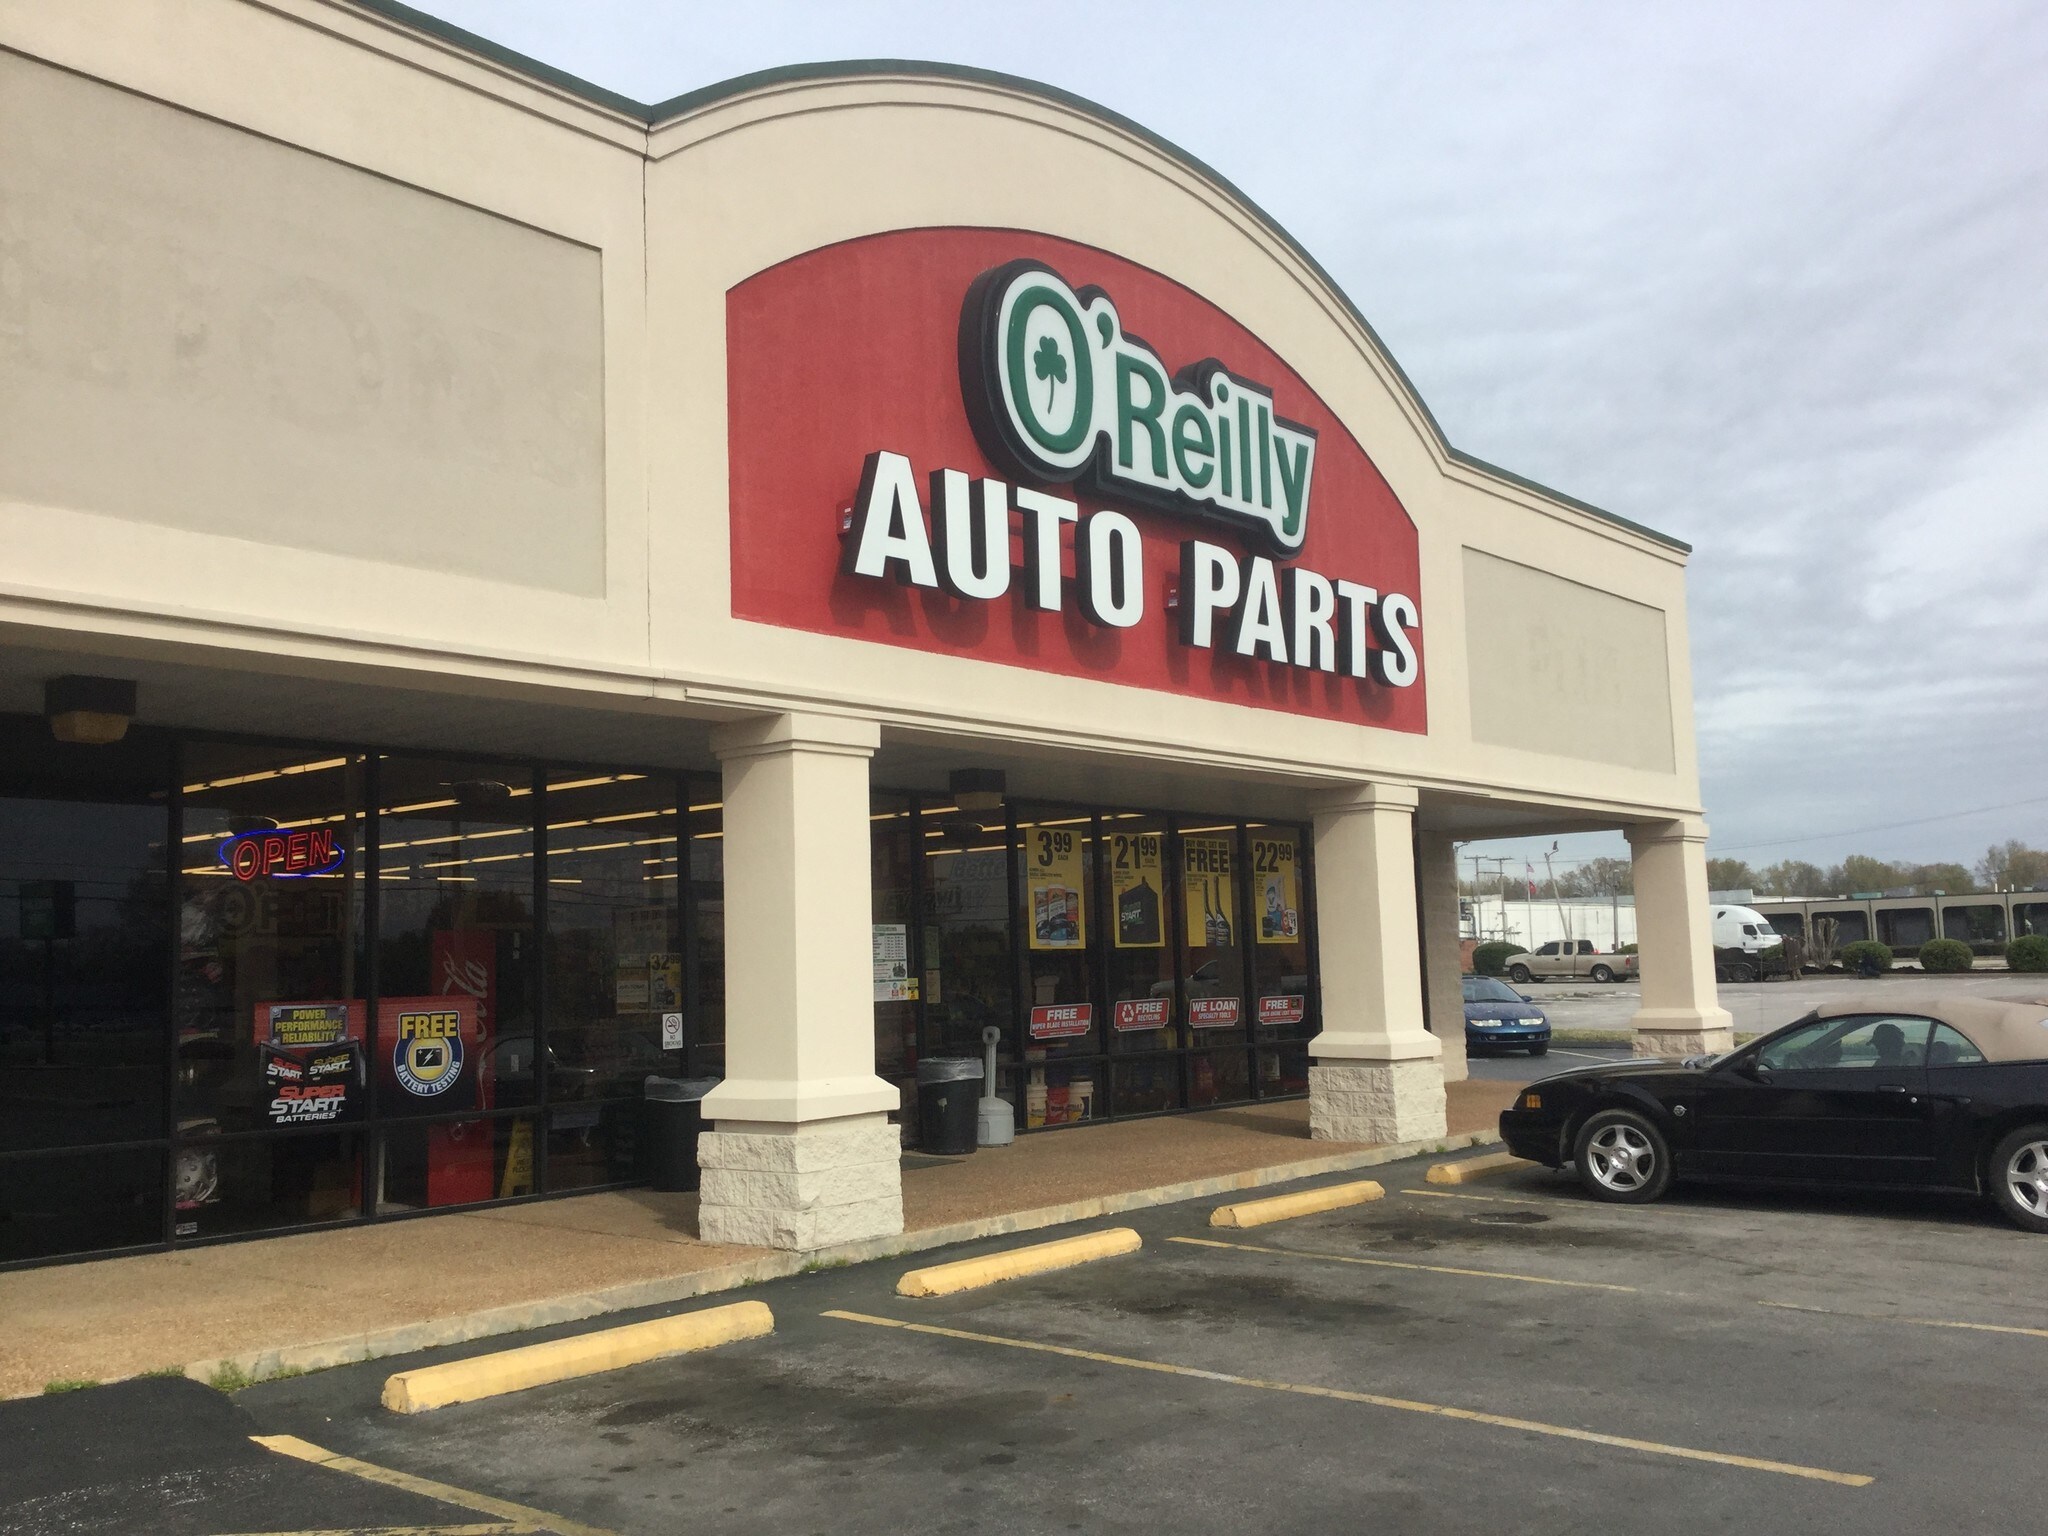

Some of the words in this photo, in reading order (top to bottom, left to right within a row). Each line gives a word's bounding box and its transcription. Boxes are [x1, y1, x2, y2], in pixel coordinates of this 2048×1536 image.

[1007, 286, 1310, 537] O'Reilly
[854, 450, 1145, 629] AUTO
[1193, 540, 1420, 689] PARTS
[233, 829, 332, 880] OPEN
[1186, 848, 1230, 873] FREE
[1121, 909, 1142, 922] START
[1135, 1002, 1163, 1014] FREE
[1192, 1002, 1208, 1012] WE
[1210, 1001, 1237, 1012] LOAN
[1265, 999, 1289, 1010] FREE
[293, 1009, 326, 1020] POWER
[1046, 1008, 1078, 1021] FREE
[275, 1019, 343, 1032] PERFORMANCE
[401, 1014, 457, 1040] FREE
[282, 1031, 336, 1043] RELIABILITY
[266, 1063, 303, 1079] START
[309, 1060, 350, 1075] START
[397, 1064, 429, 1094] BATTERY
[431, 1060, 460, 1092] TESTING
[279, 1085, 346, 1100] SUPER
[269, 1096, 346, 1116] START
[276, 1111, 337, 1124] BATTERIES
